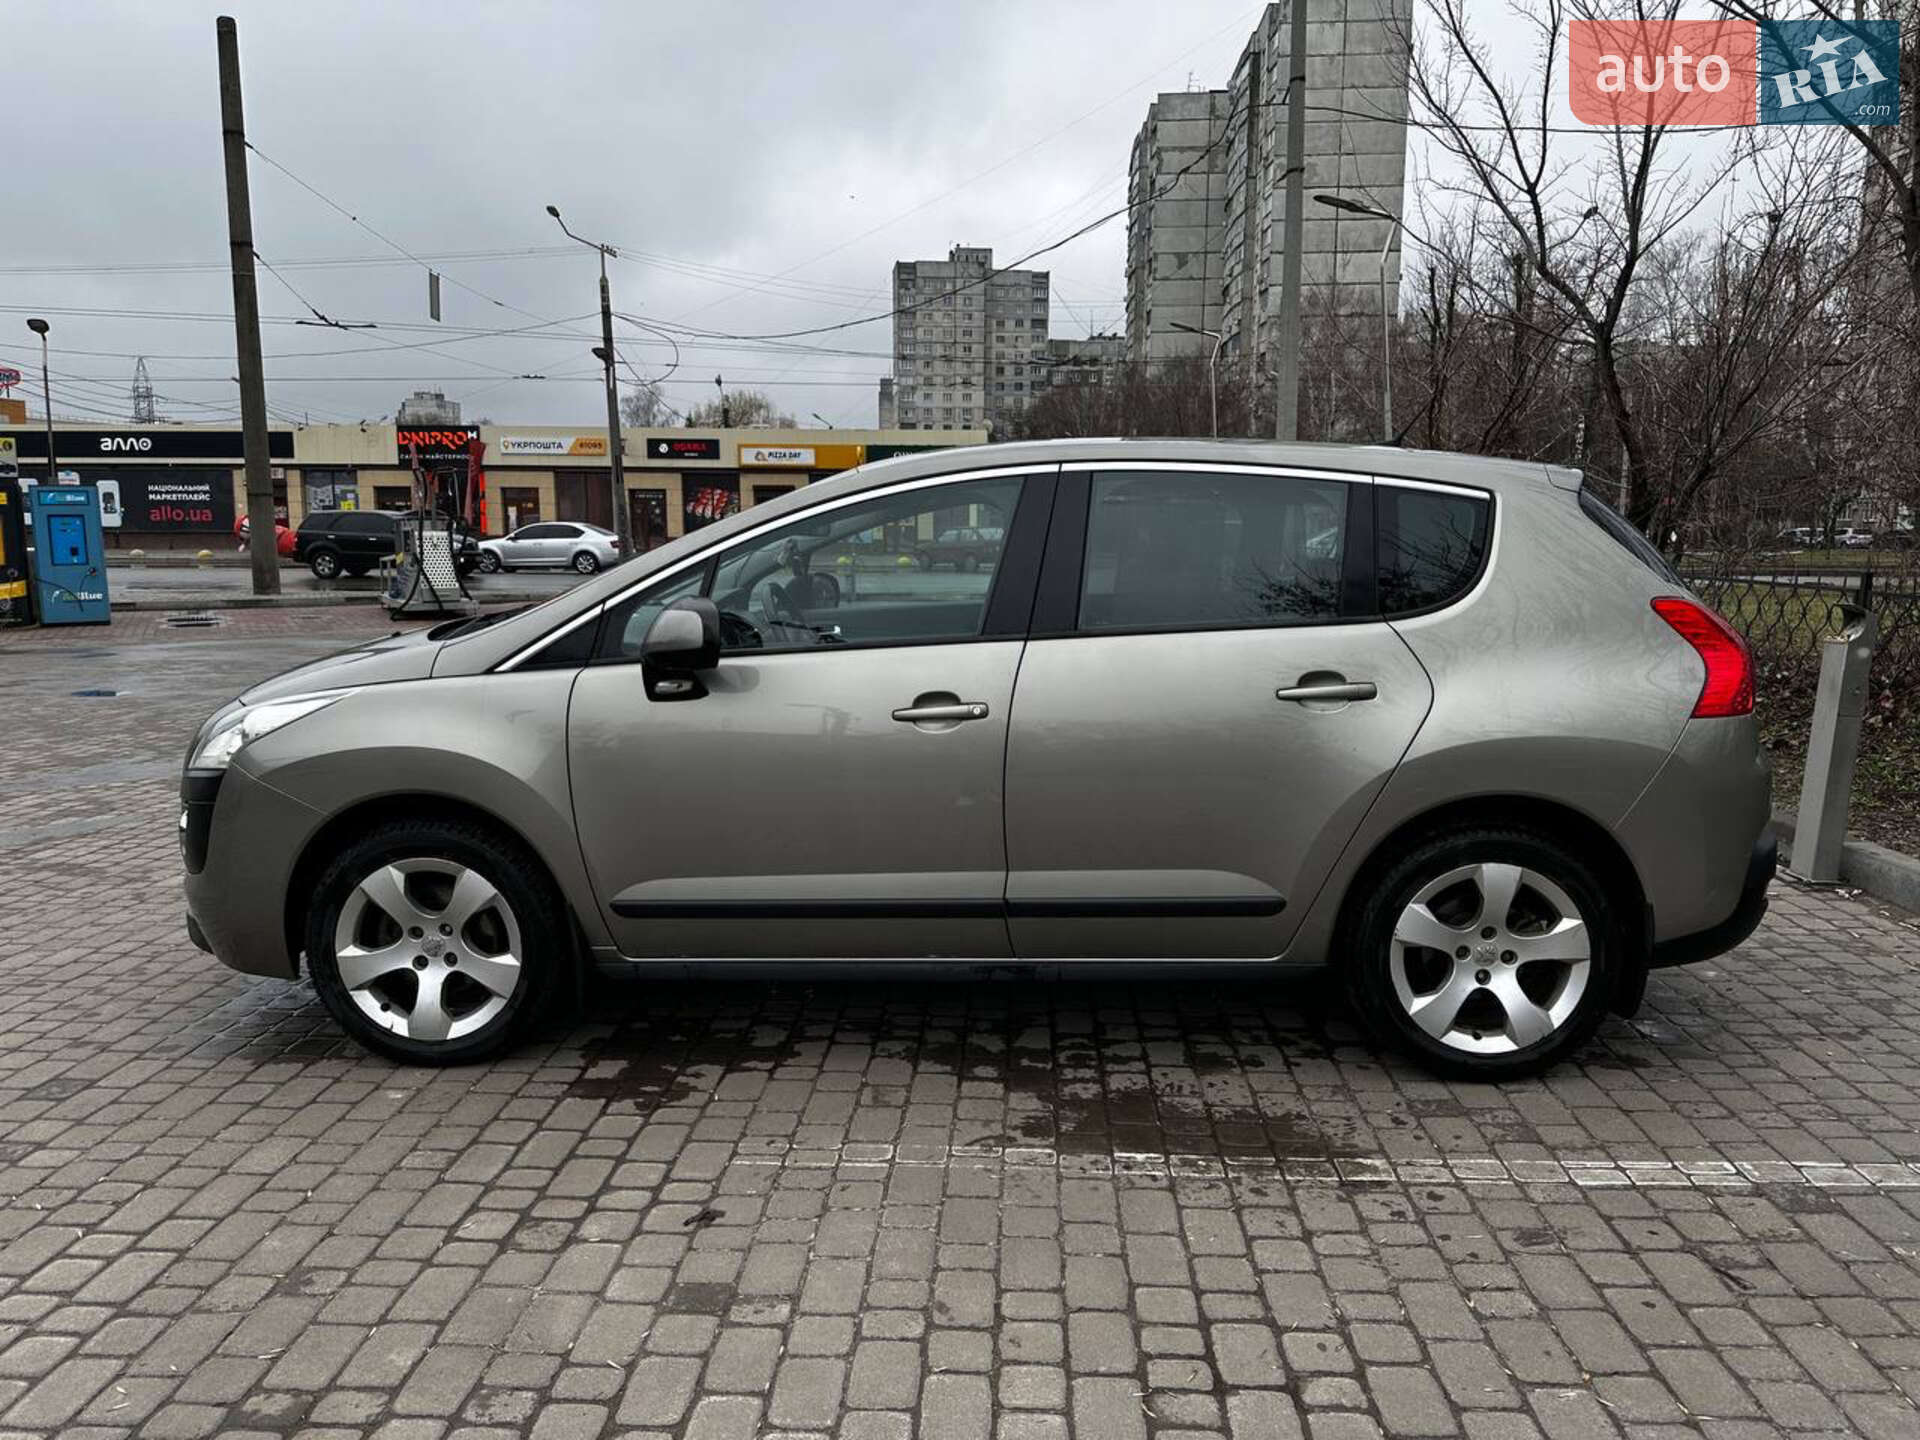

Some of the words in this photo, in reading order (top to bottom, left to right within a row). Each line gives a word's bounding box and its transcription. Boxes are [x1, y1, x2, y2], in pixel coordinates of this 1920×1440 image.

[511, 441, 564, 450] УКРПОШТА
[148, 483, 210, 494] НАЦІОНАЛЬНИЙ
[148, 492, 212, 501] МАРКЕТПЛЕЙС
[149, 506, 213, 521] allo.ua
